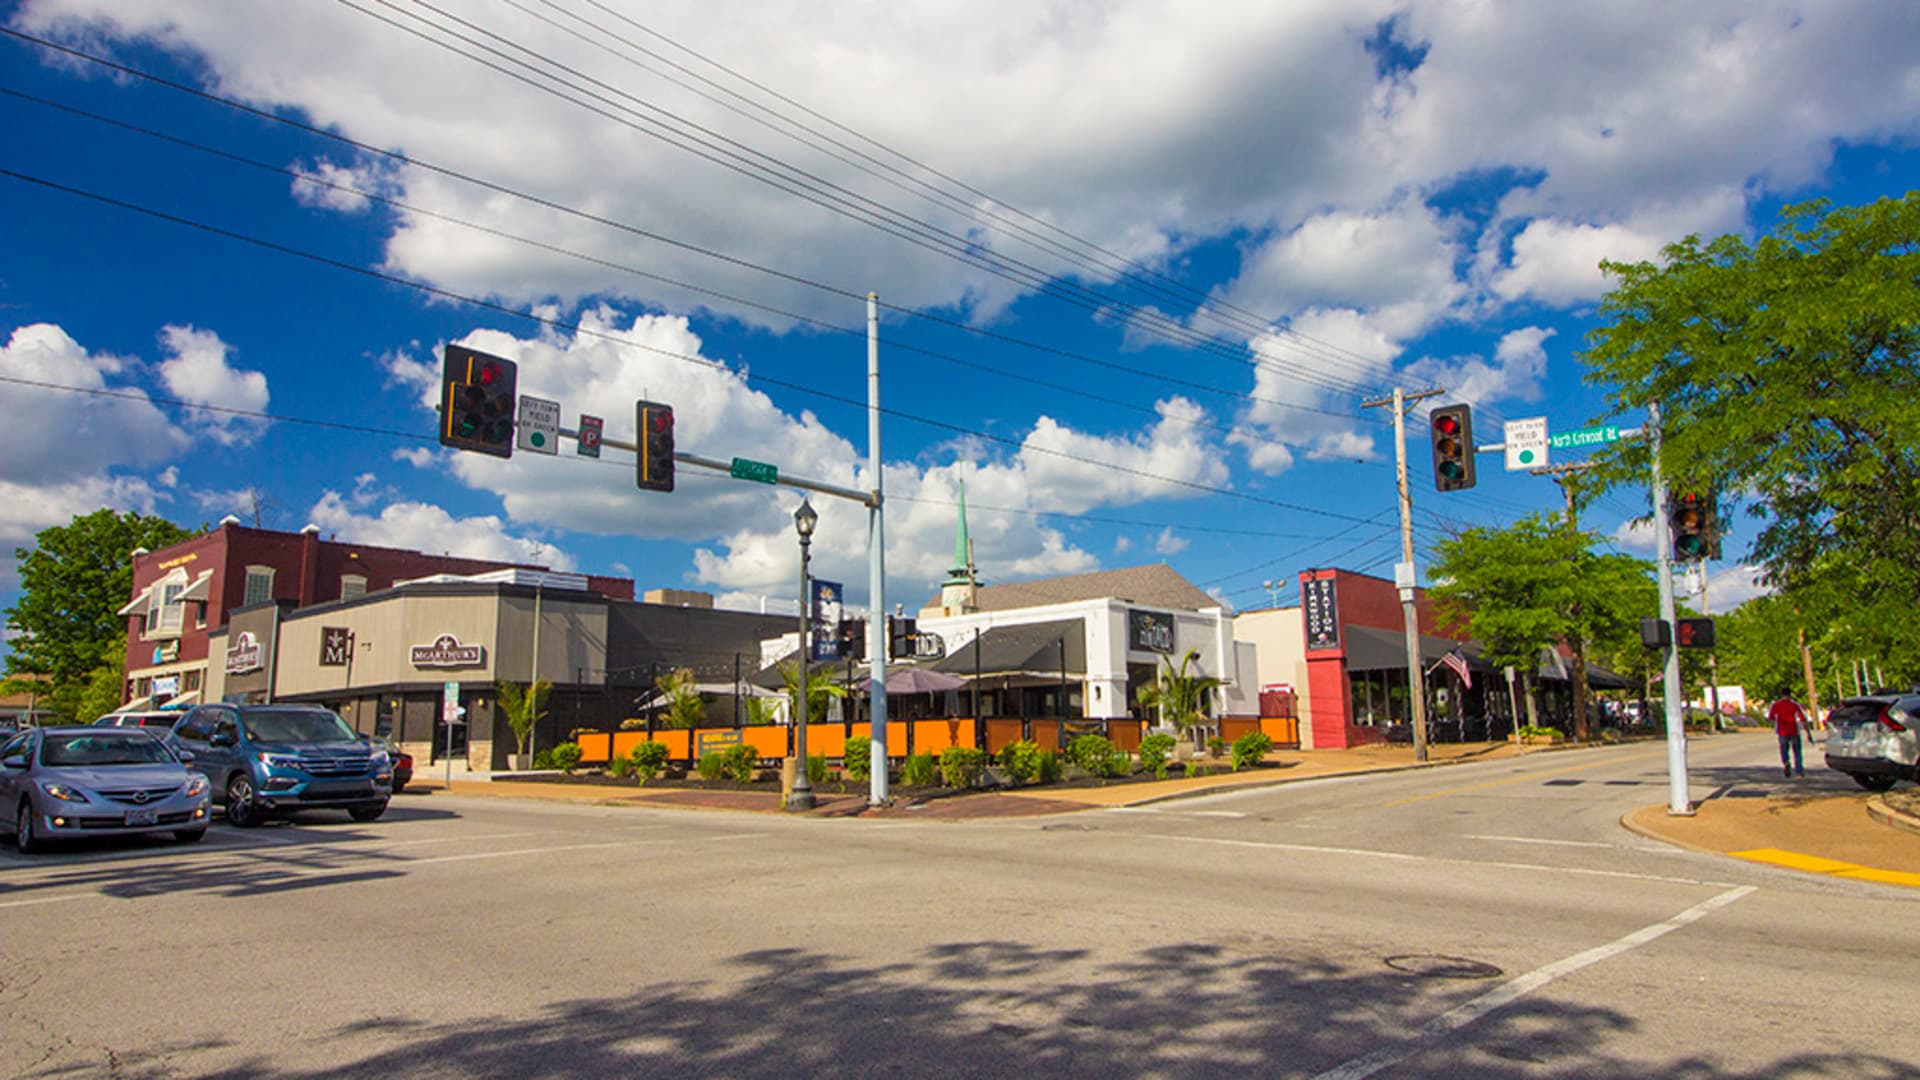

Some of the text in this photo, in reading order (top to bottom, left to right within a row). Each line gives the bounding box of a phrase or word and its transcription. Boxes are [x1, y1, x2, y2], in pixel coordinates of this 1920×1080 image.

[528, 409, 552, 423] YIELD
[1514, 430, 1538, 440] YIELD
[1308, 582, 1320, 634] KIRKWOOD
[1321, 580, 1333, 633] STATION
[325, 647, 343, 663] M
